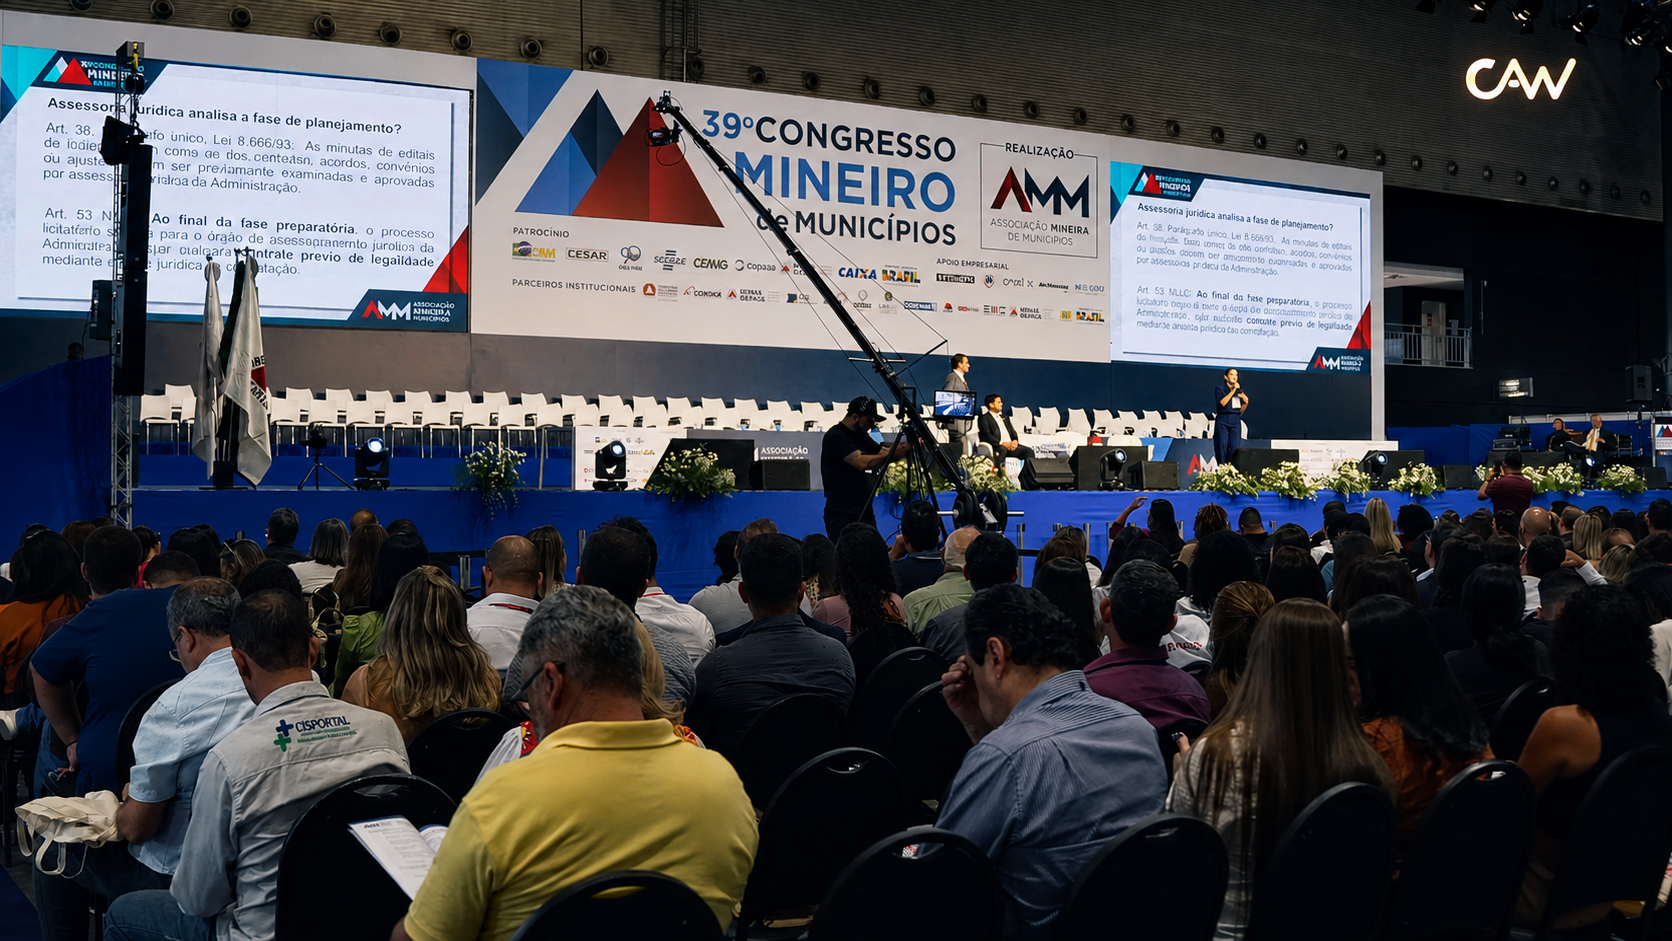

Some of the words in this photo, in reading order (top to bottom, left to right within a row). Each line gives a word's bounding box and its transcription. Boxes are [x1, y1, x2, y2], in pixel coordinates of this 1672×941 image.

[136, 104, 184, 118] urídica
[188, 109, 237, 121] analisa
[241, 113, 249, 122] a
[253, 112, 281, 125] fase
[285, 115, 301, 126] de
[305, 117, 402, 134] planejamento?
[44, 137, 60, 148] de
[45, 122, 68, 134] Art.
[75, 124, 94, 136] 38.
[213, 134, 232, 146] Lei
[305, 141, 321, 152] As
[326, 143, 373, 156] minutas
[378, 147, 393, 157] de
[398, 148, 435, 160] editais
[755, 115, 957, 163] CONGRESSO
[1005, 142, 1074, 160] REALIZAÇÃO
[171, 162, 191, 172] ser
[281, 170, 354, 183] examinadas
[360, 174, 368, 183] e
[374, 175, 435, 188] aprovadas
[192, 176, 207, 187] da
[734, 150, 956, 213] MINEIRO
[990, 166, 1090, 219] AMM
[44, 207, 67, 219] Art.
[76, 209, 93, 220] 53
[151, 213, 170, 224] Ao
[179, 214, 207, 226] final
[216, 216, 232, 227] da
[240, 217, 268, 229] fase
[366, 228, 374, 236] o
[381, 227, 435, 239] processo
[1137, 202, 1184, 216] Assessoria
[1217, 213, 1245, 222] analisa
[1252, 215, 1269, 225] fase
[1270, 218, 1279, 226] de
[1281, 219, 1334, 231] planejamento?
[512, 226, 570, 238] PATROCÍNIO
[795, 210, 957, 246] MUNICÍPIOS
[990, 218, 1048, 231] ASSOCIAÇÃO
[1050, 223, 1090, 235] MINEIRA
[160, 230, 188, 241] para
[194, 232, 202, 241] o
[248, 233, 264, 244] de
[1007, 232, 1020, 241] DE
[42, 254, 103, 267] mediante
[300, 251, 341, 263] previo
[349, 252, 364, 263] de
[567, 249, 608, 261] CESAR
[936, 258, 960, 266] APOIO
[961, 260, 1010, 270] EMPRESARIAL
[838, 267, 878, 280] CAIXA
[512, 278, 563, 289] PARCEIROS
[565, 282, 636, 293] INSTITUCIONAIS
[1196, 290, 1208, 299] Ao
[1212, 291, 1230, 300] final
[361, 299, 411, 320] AMM
[1313, 354, 1341, 371] AMM
[760, 445, 809, 457] ASSOCIAÇÃO
[295, 715, 351, 732] CISPORTAL
